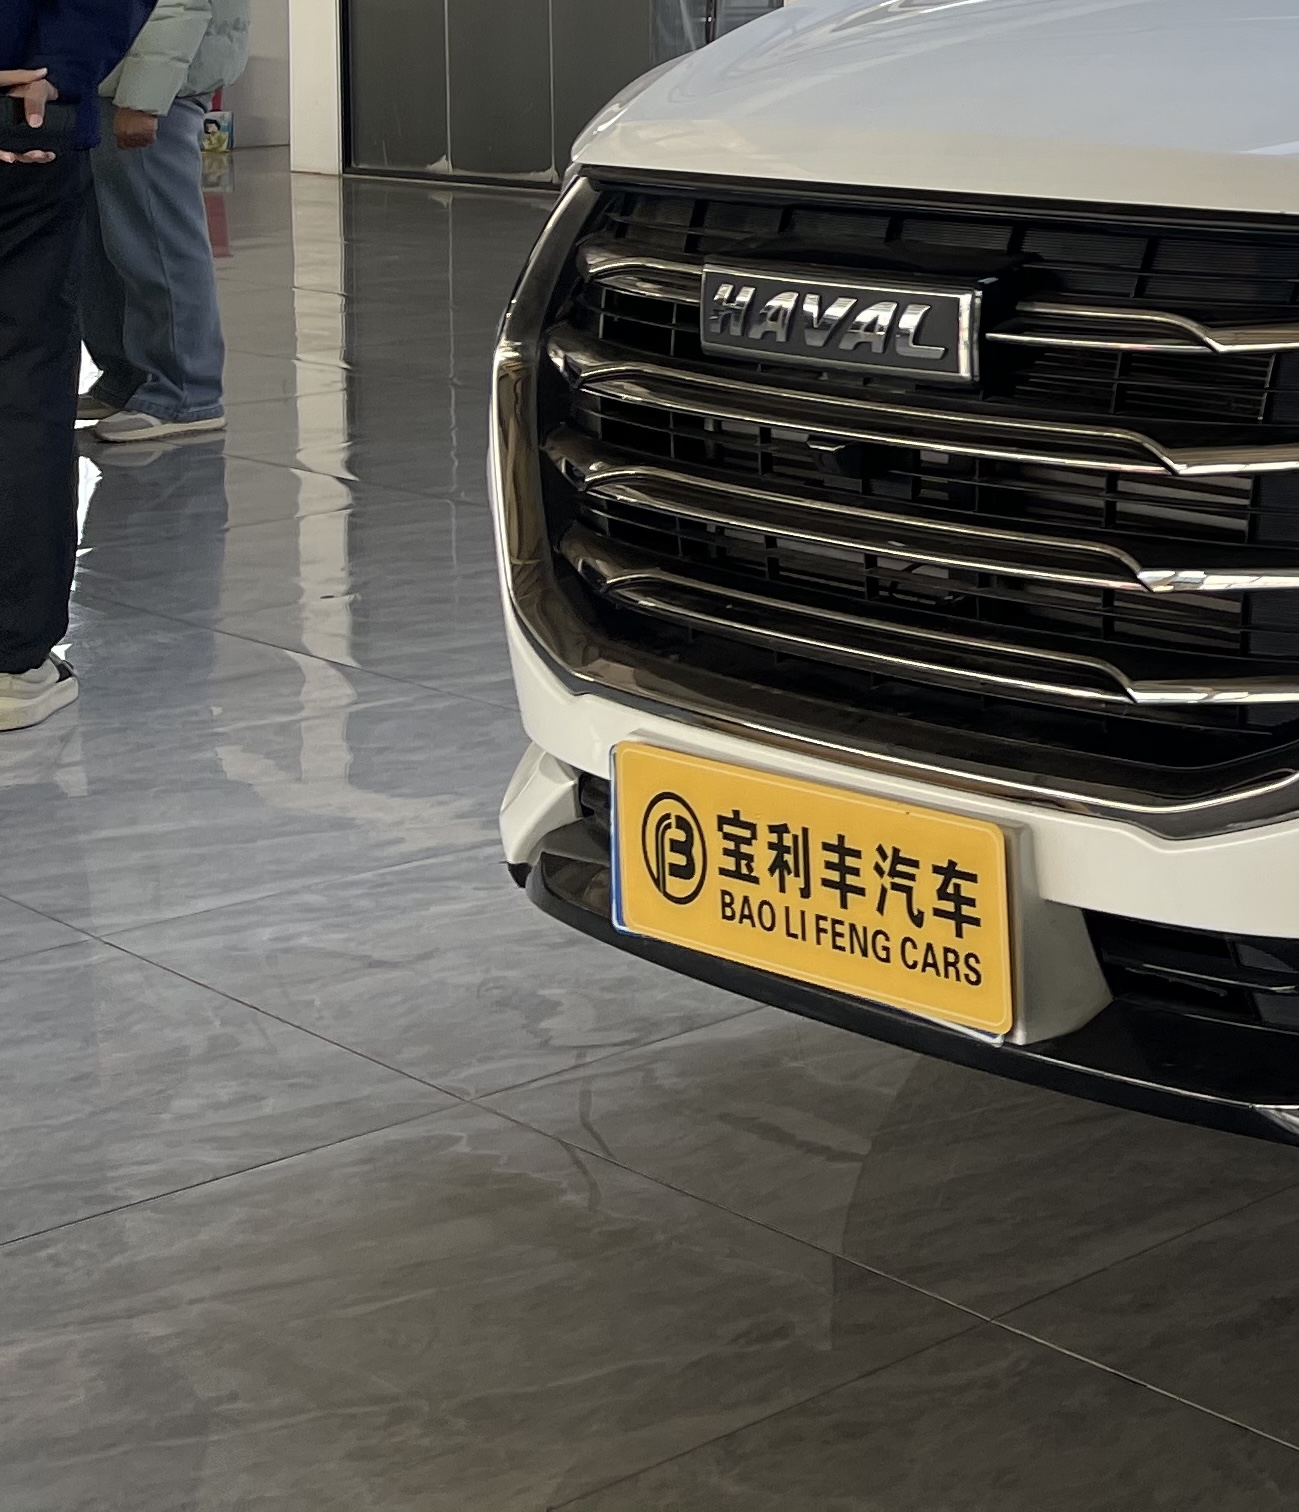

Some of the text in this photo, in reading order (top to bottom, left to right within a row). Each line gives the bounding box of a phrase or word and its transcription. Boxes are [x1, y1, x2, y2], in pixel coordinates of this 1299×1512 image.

[708, 283, 946, 360] HAVAL
[716, 809, 982, 939] 宝利丰汽车
[719, 889, 982, 986] BAO LI FENG CARS
